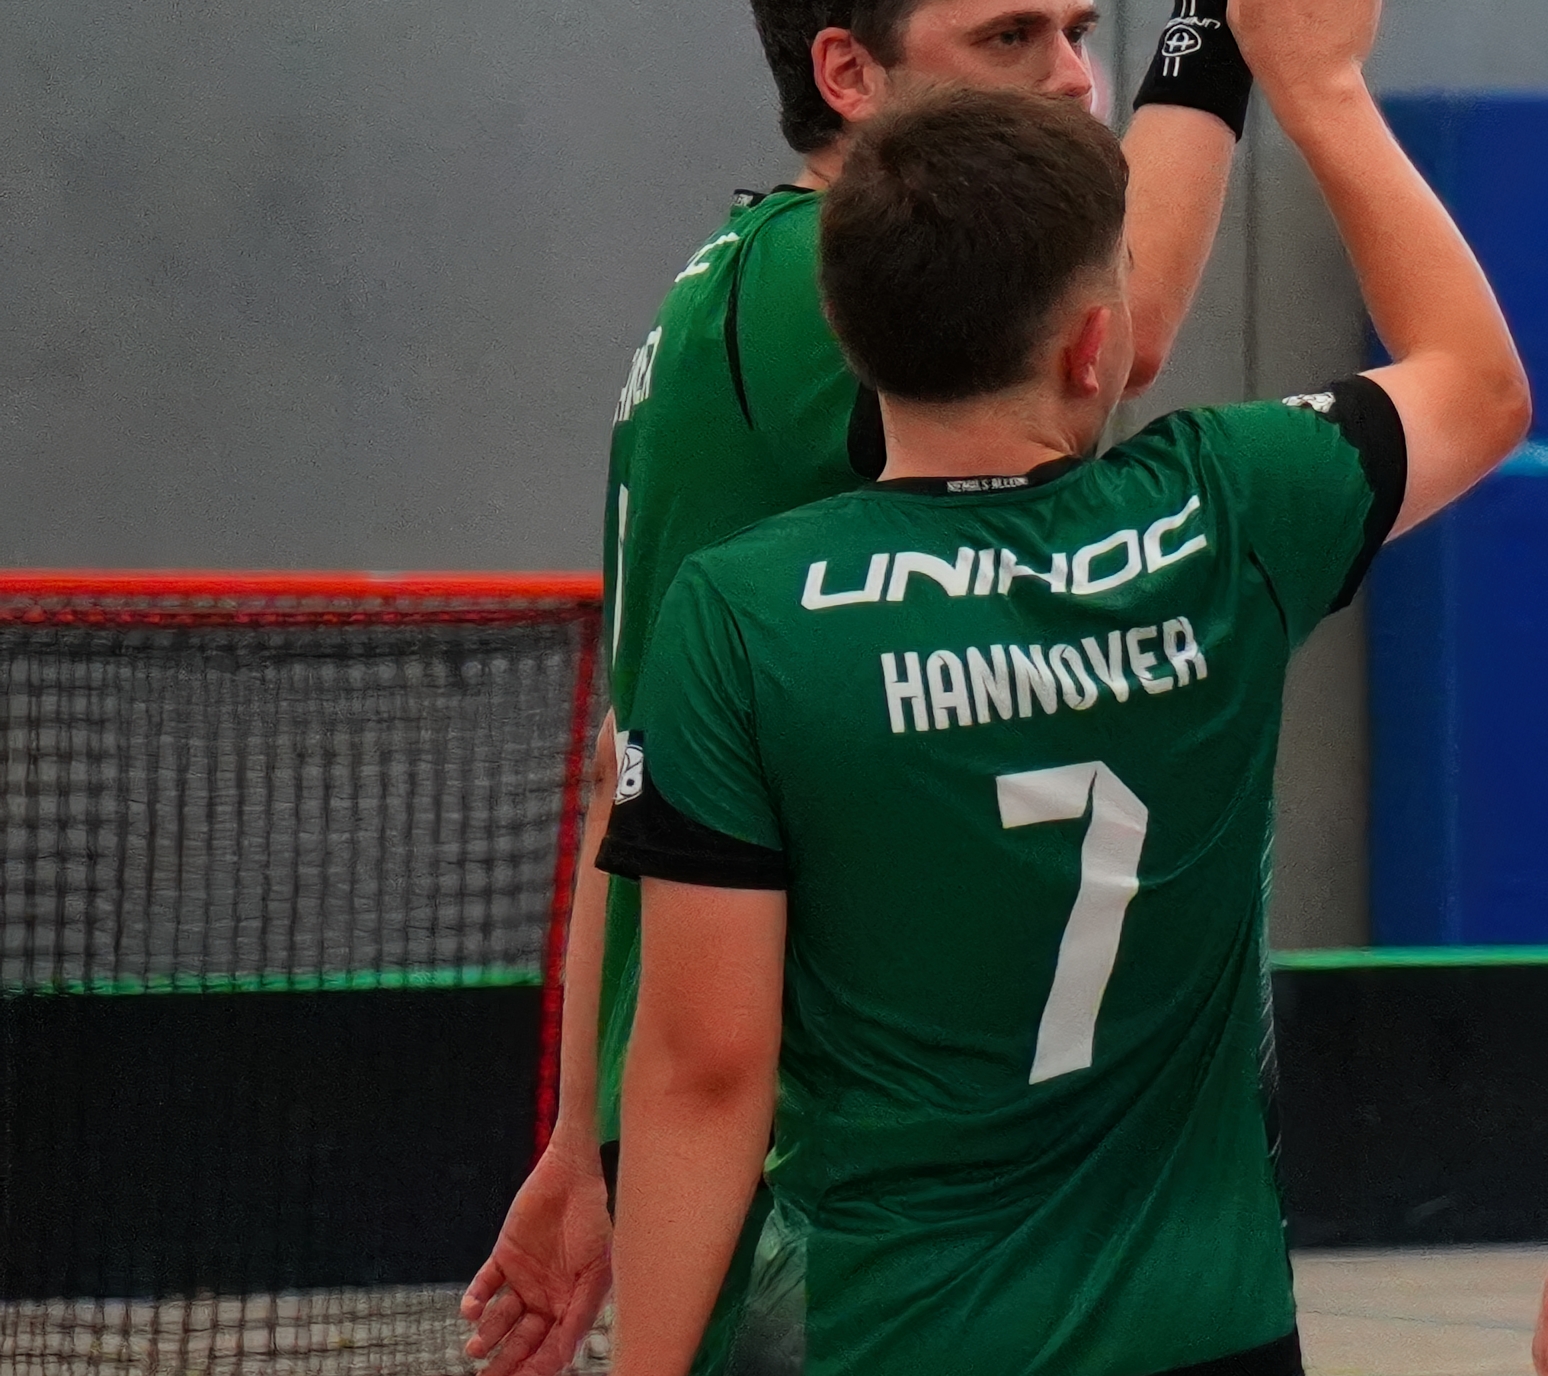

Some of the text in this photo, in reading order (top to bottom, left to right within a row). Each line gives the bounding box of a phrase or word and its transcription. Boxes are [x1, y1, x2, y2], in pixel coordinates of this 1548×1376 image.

[801, 495, 1208, 610] UNIHOC
[880, 616, 1208, 733] HANNOVER
[996, 761, 1148, 1084] 7
